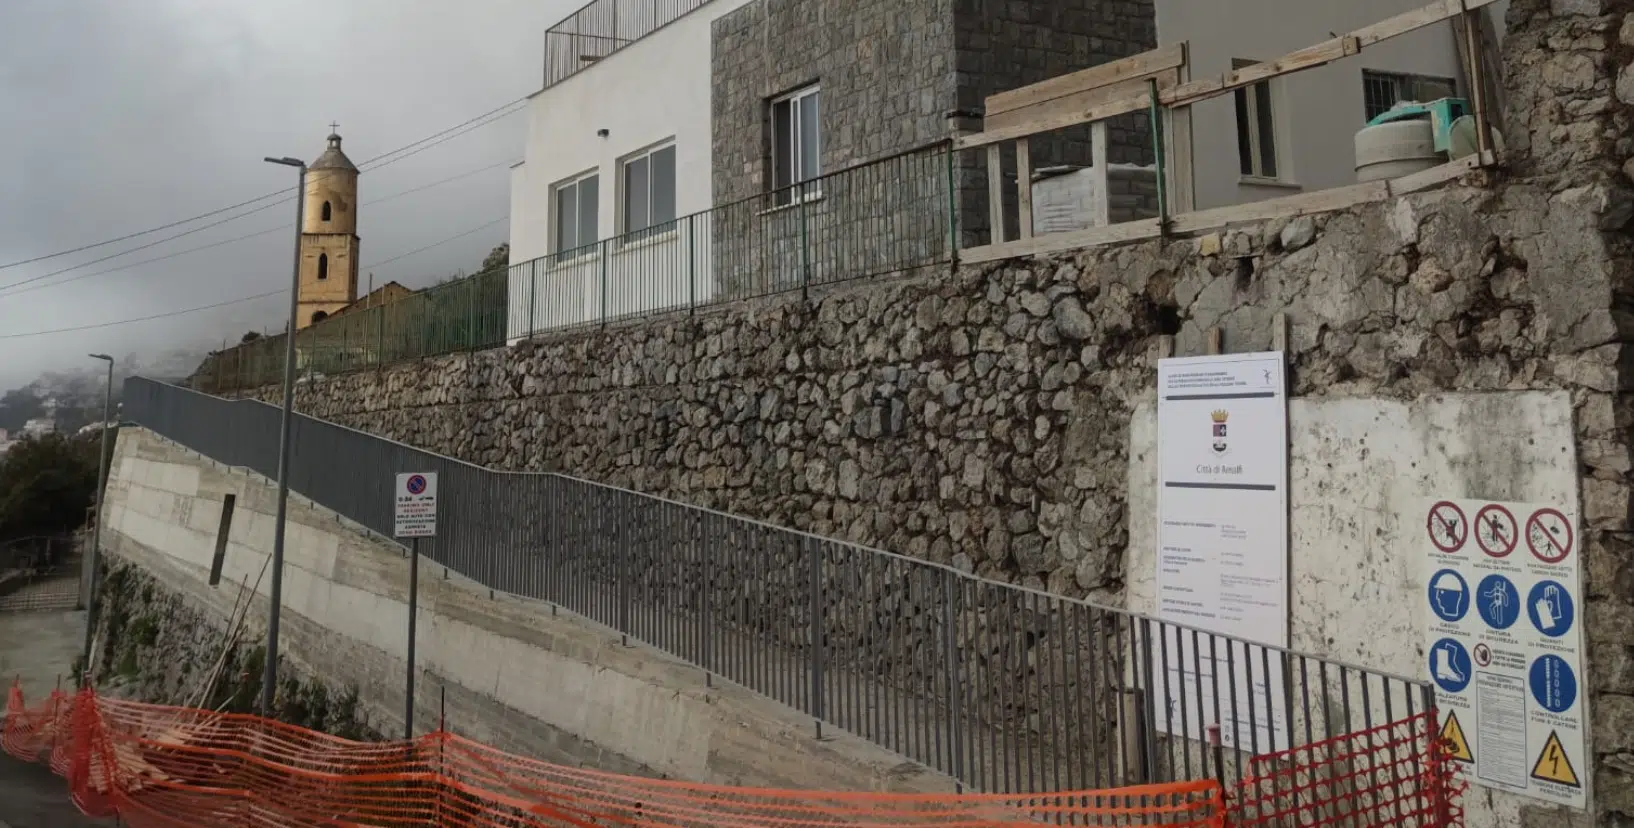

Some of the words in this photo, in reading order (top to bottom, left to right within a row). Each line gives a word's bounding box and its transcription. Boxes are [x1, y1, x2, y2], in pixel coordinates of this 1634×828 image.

[1196, 464, 1212, 474] Città
[1213, 465, 1220, 473] di
[1222, 464, 1243, 474] Amalfi
[1435, 627, 1471, 637] PROTEZIONE
[1486, 635, 1519, 644] SICUREZZA
[1540, 637, 1564, 646] GUANTI
[1536, 642, 1575, 654] PROTEZIONE
